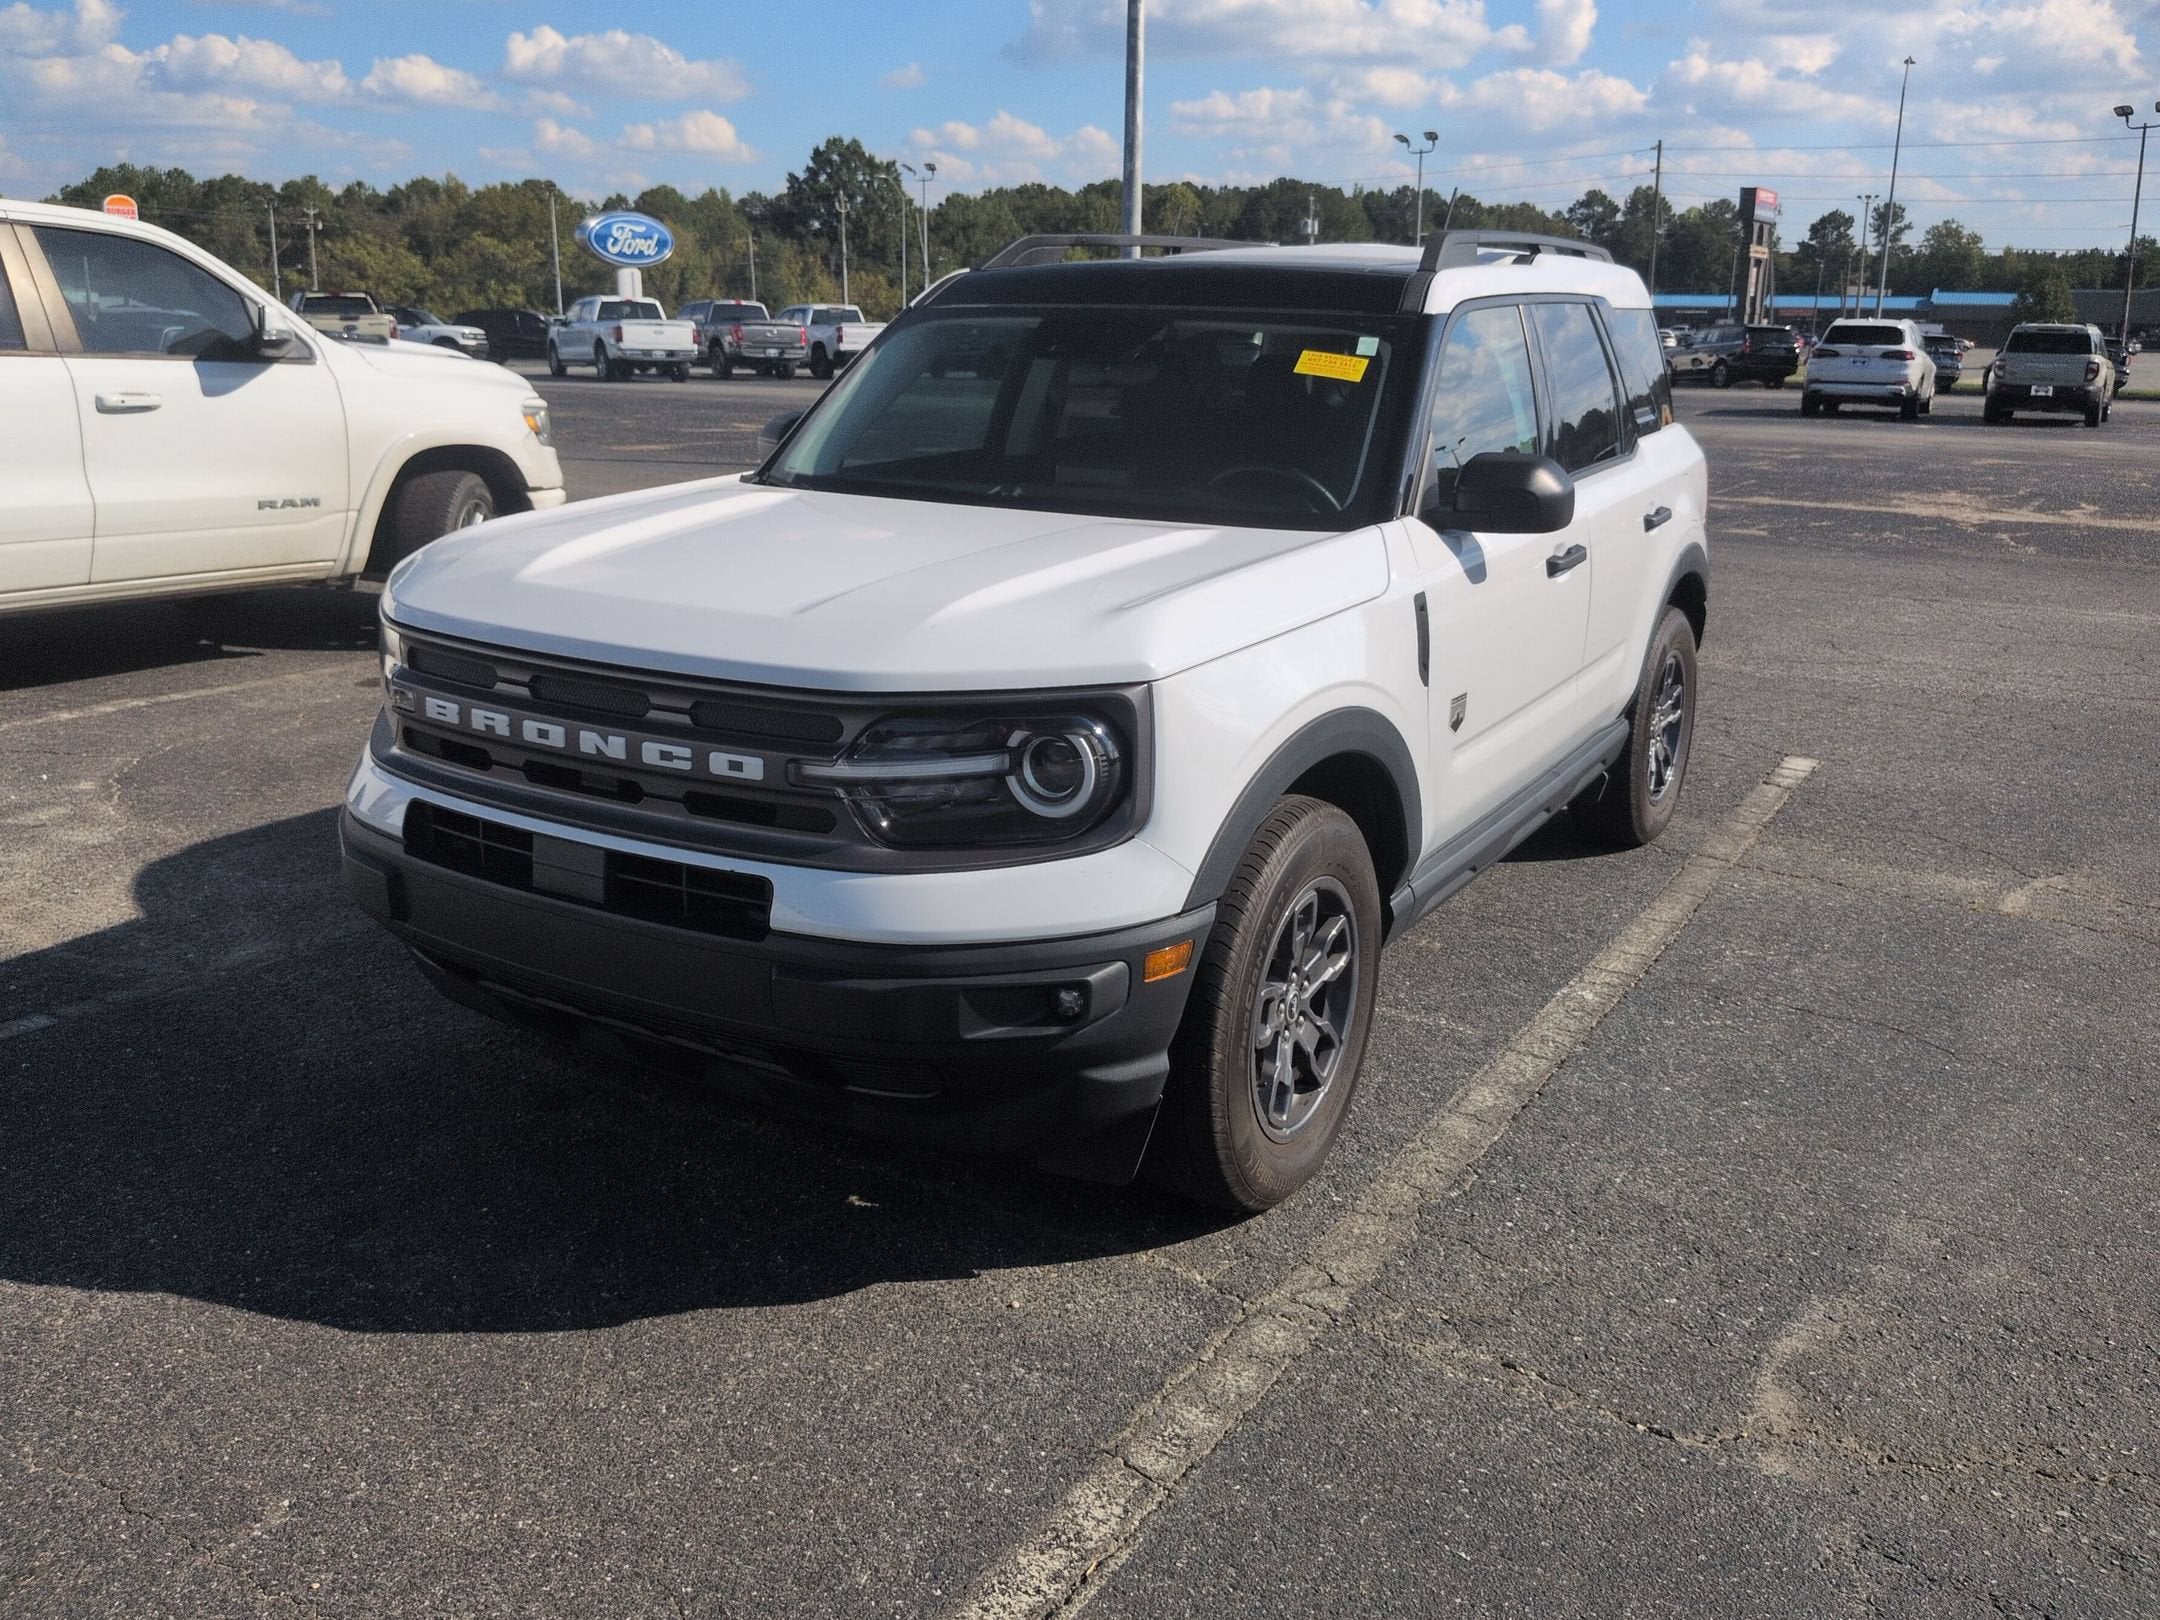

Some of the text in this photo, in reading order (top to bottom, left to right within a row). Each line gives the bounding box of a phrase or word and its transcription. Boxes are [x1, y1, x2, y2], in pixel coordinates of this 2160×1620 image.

[607, 221, 659, 256] Ford
[258, 498, 320, 510] RAM
[425, 696, 764, 781] BRONCO
